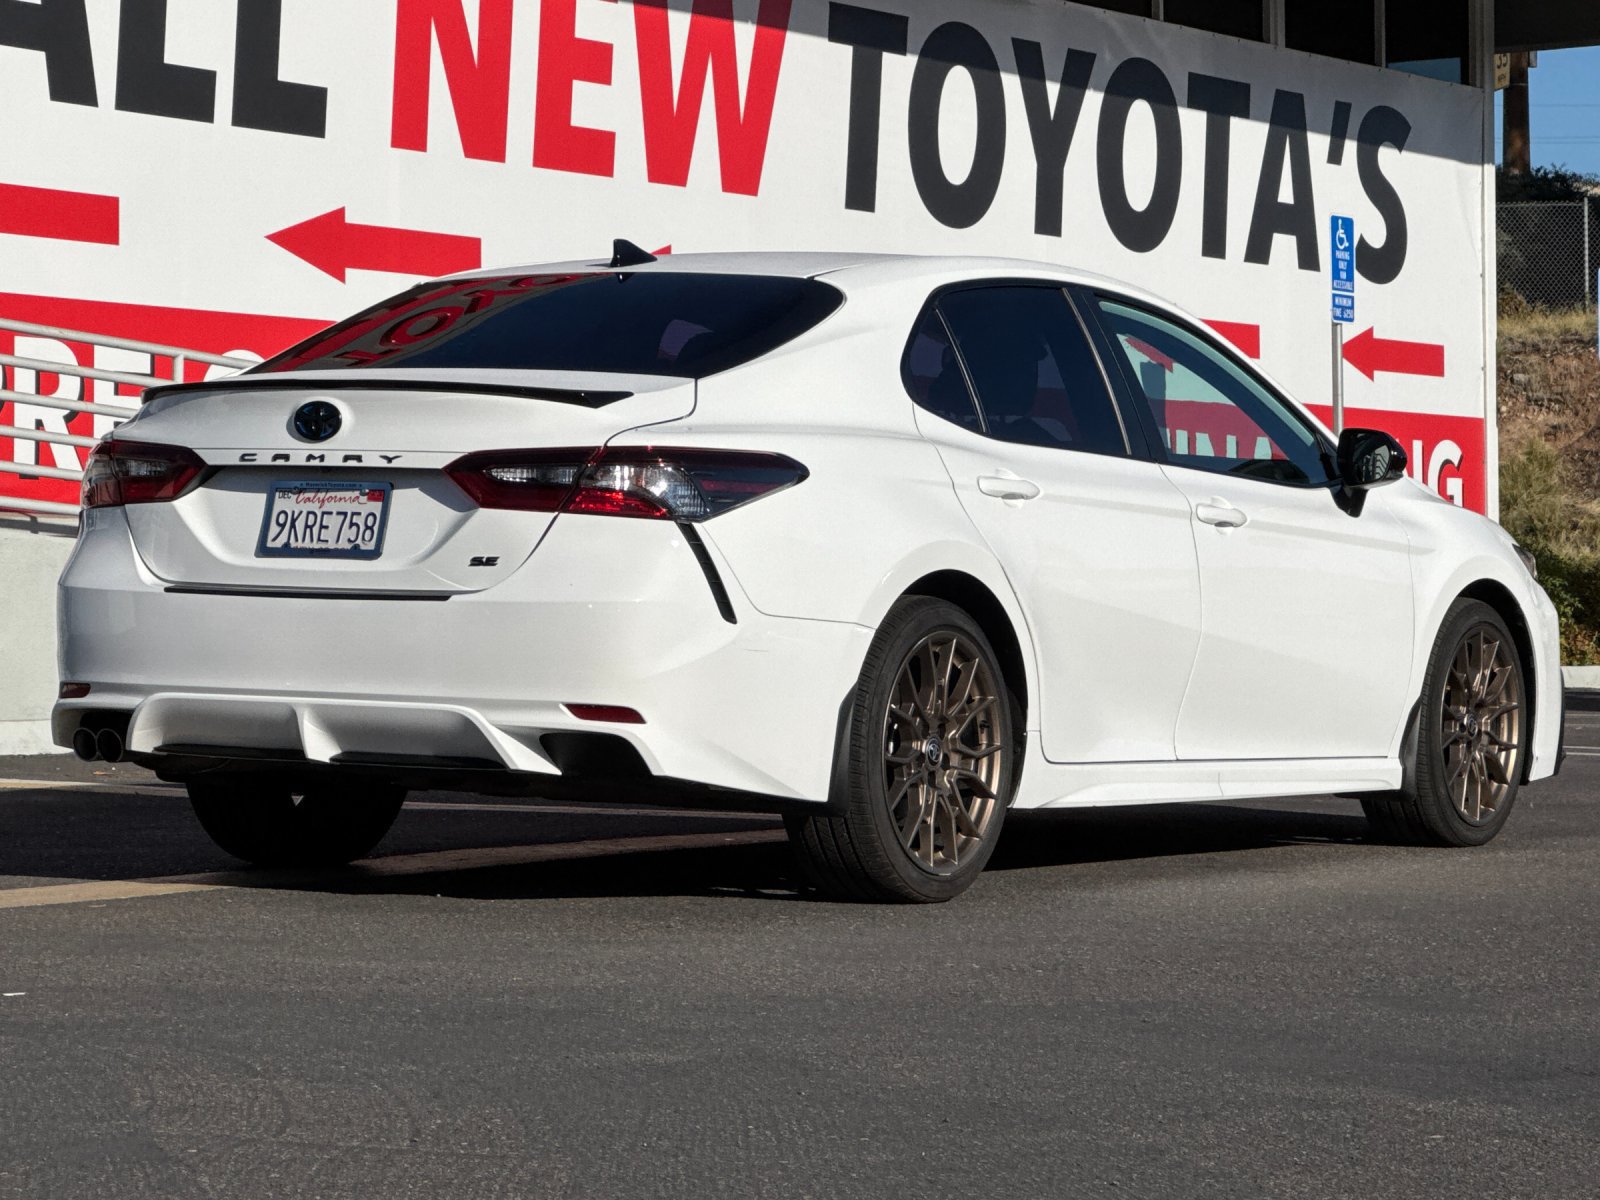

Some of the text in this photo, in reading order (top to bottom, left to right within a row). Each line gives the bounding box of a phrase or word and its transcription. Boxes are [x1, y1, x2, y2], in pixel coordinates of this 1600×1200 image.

[390, 0, 793, 197] NEW
[828, 2, 1412, 285] TOYOTA'S
[239, 453, 402, 464] CAMRY
[295, 488, 367, 509] California
[270, 509, 378, 545] 9KRE758
[468, 556, 501, 567] SE
